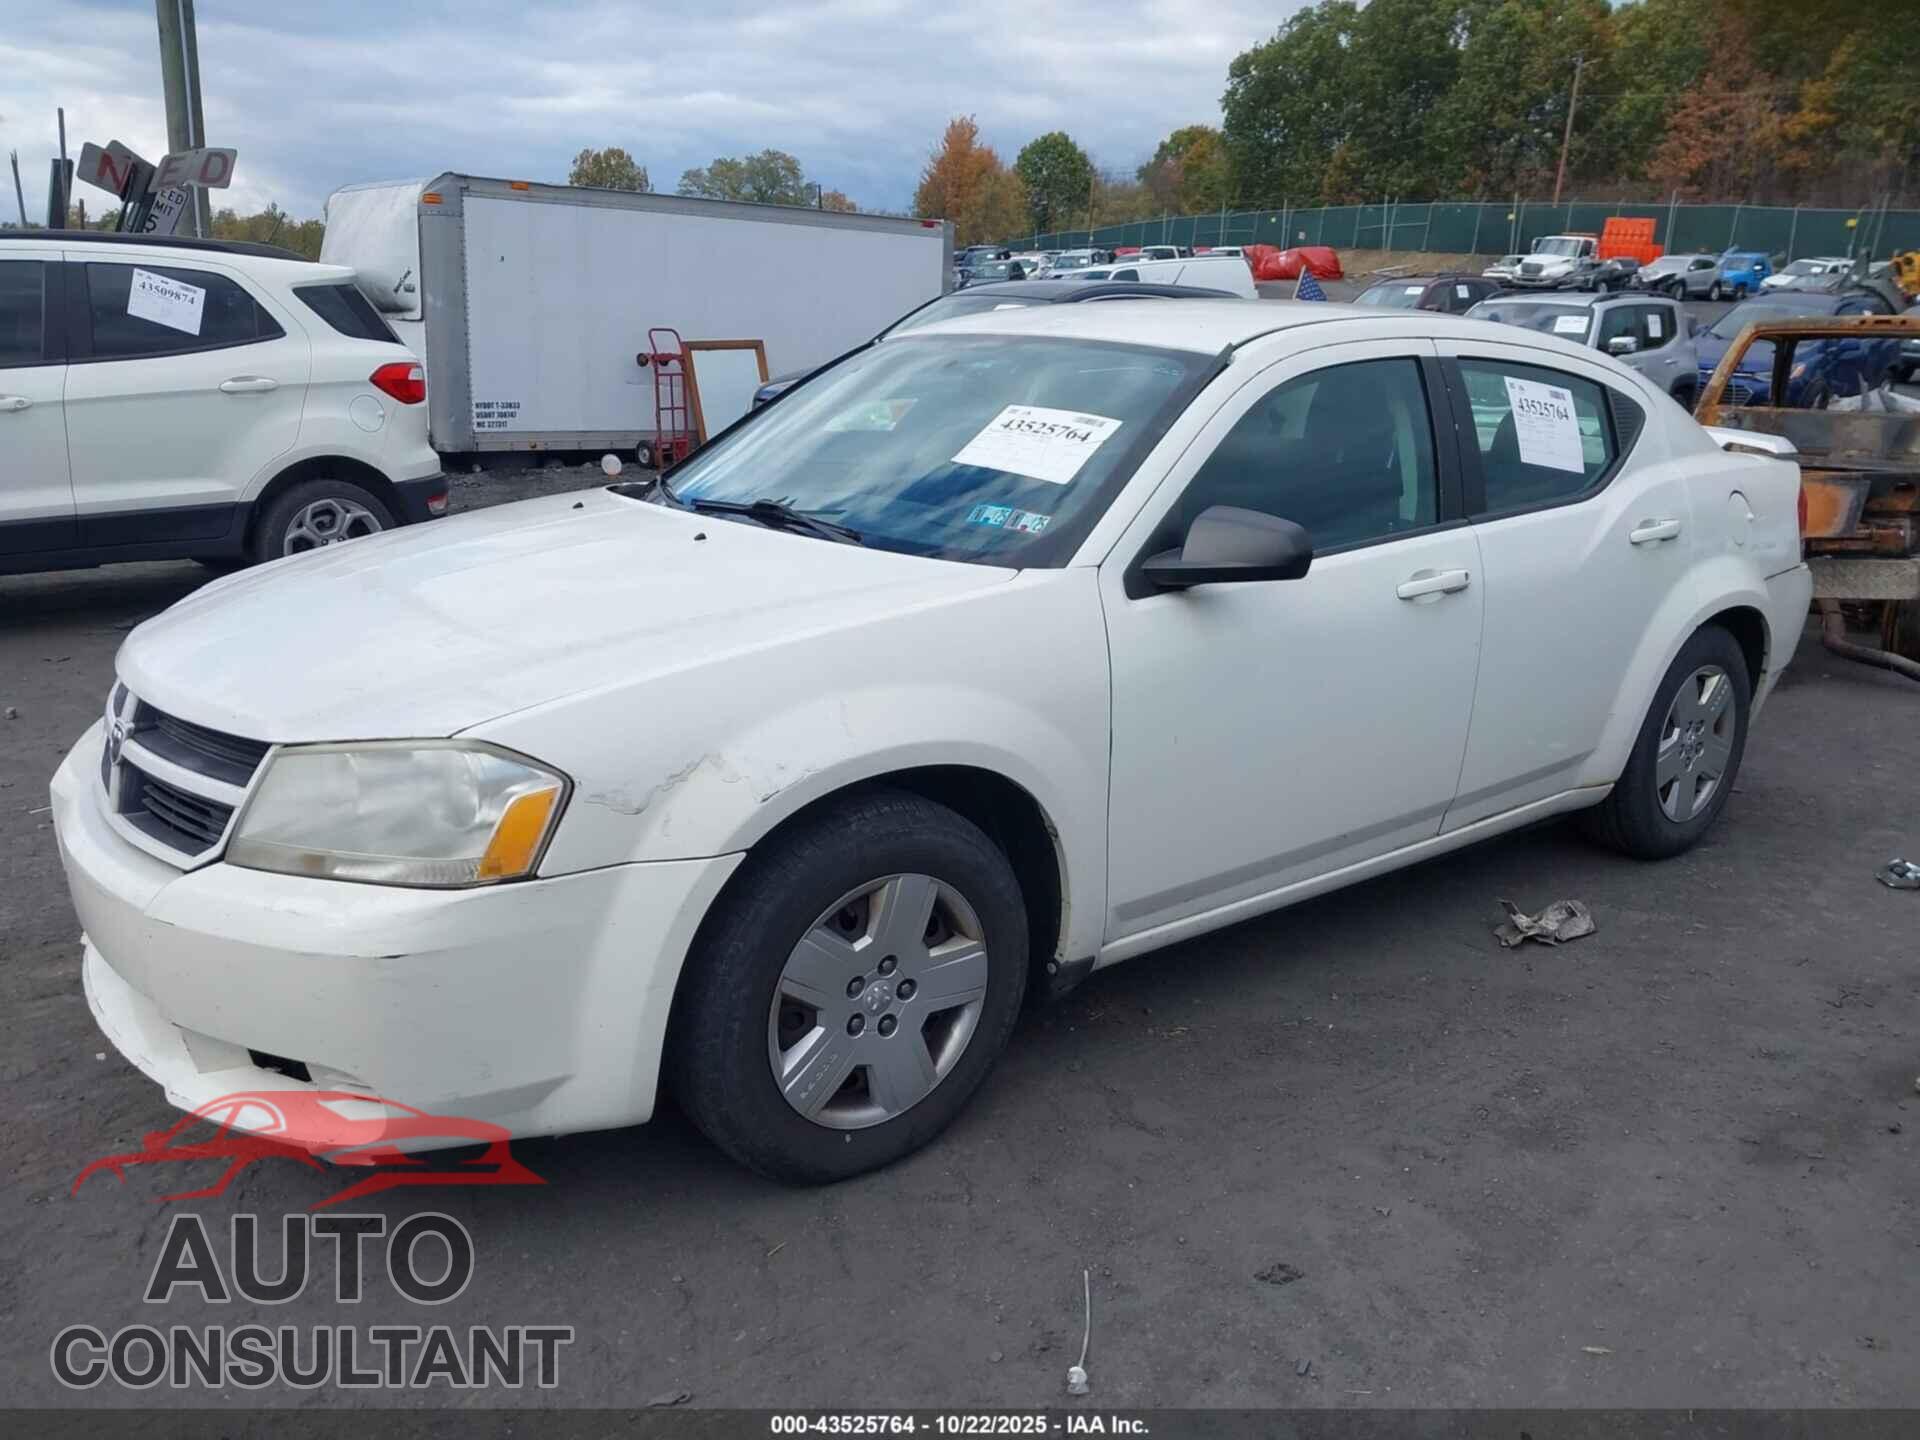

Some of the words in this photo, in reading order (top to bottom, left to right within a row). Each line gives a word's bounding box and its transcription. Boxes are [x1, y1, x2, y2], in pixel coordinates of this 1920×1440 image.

[138, 280, 195, 305] 43509874
[1518, 397, 1569, 421] 43525764
[1000, 417, 1093, 443] 43525764
